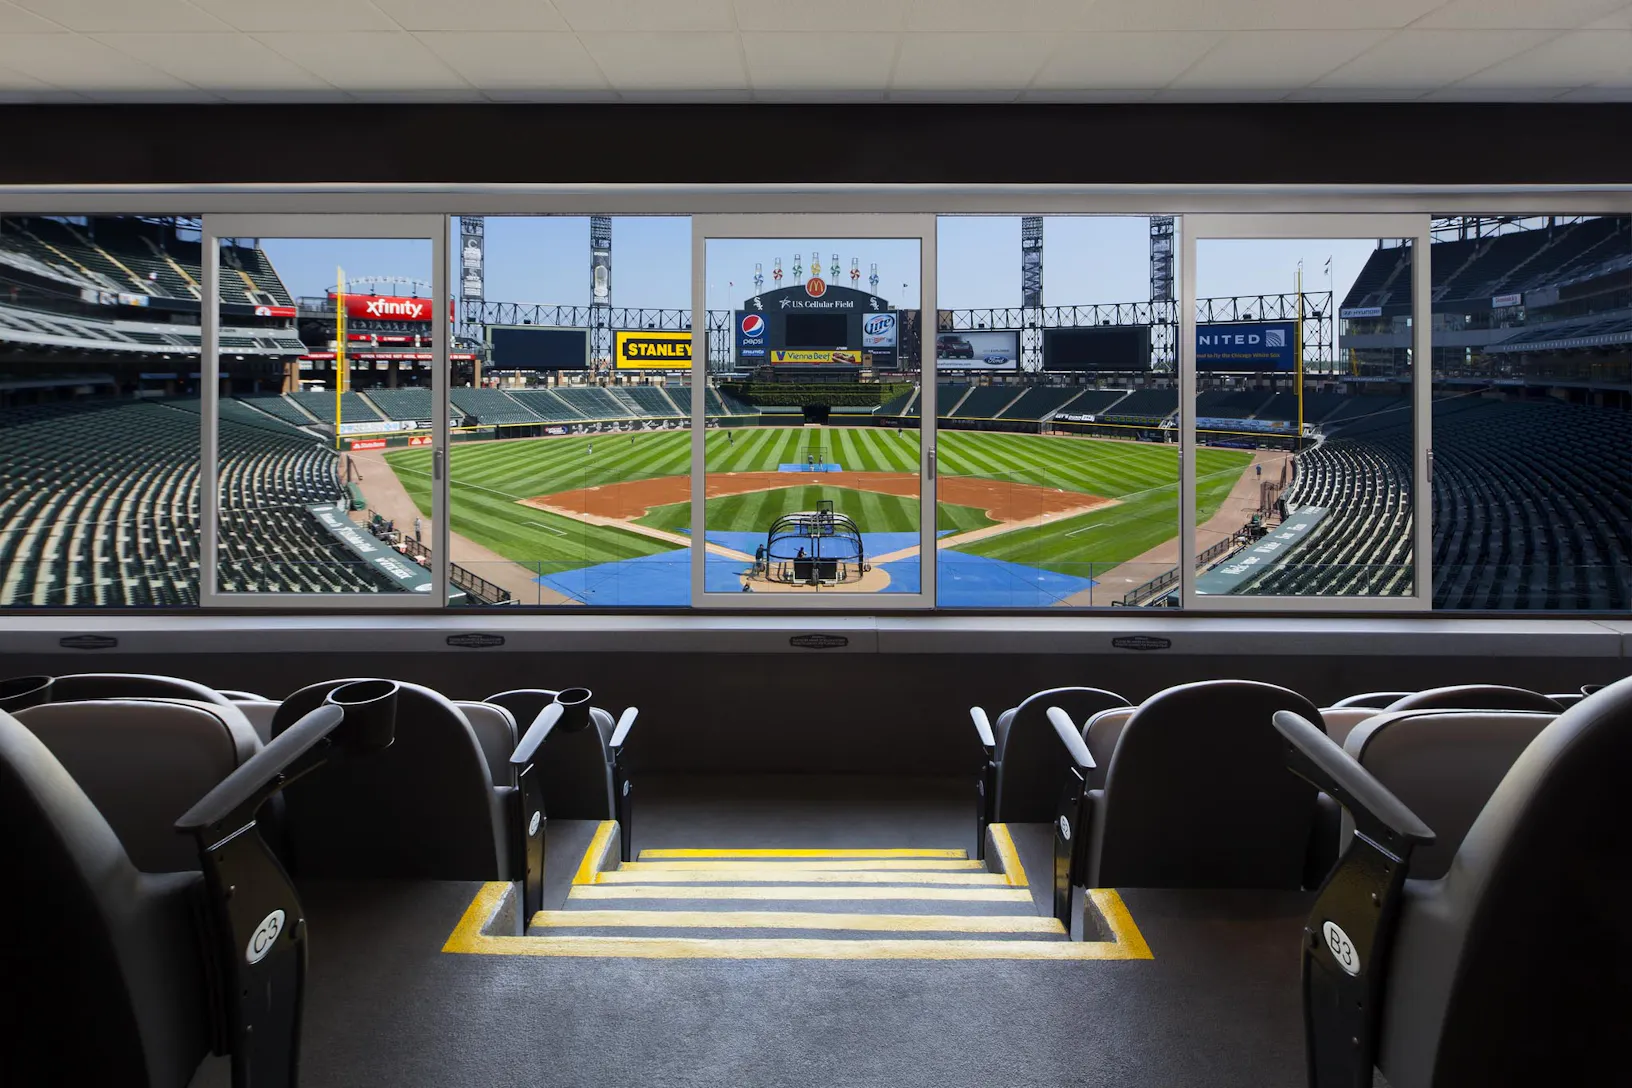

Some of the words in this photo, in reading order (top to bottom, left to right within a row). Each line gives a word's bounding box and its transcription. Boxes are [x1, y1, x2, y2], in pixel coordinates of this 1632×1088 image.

[366, 299, 423, 318] xfinity
[804, 300, 834, 308] Cellular
[835, 300, 854, 308] Field
[1199, 334, 1261, 346] NITED
[628, 342, 692, 357] STANLEY
[788, 352, 812, 360] Vienna
[813, 352, 830, 361] Beef
[987, 356, 1004, 364] Ford
[254, 917, 278, 954] C3
[1330, 926, 1352, 966] B3
